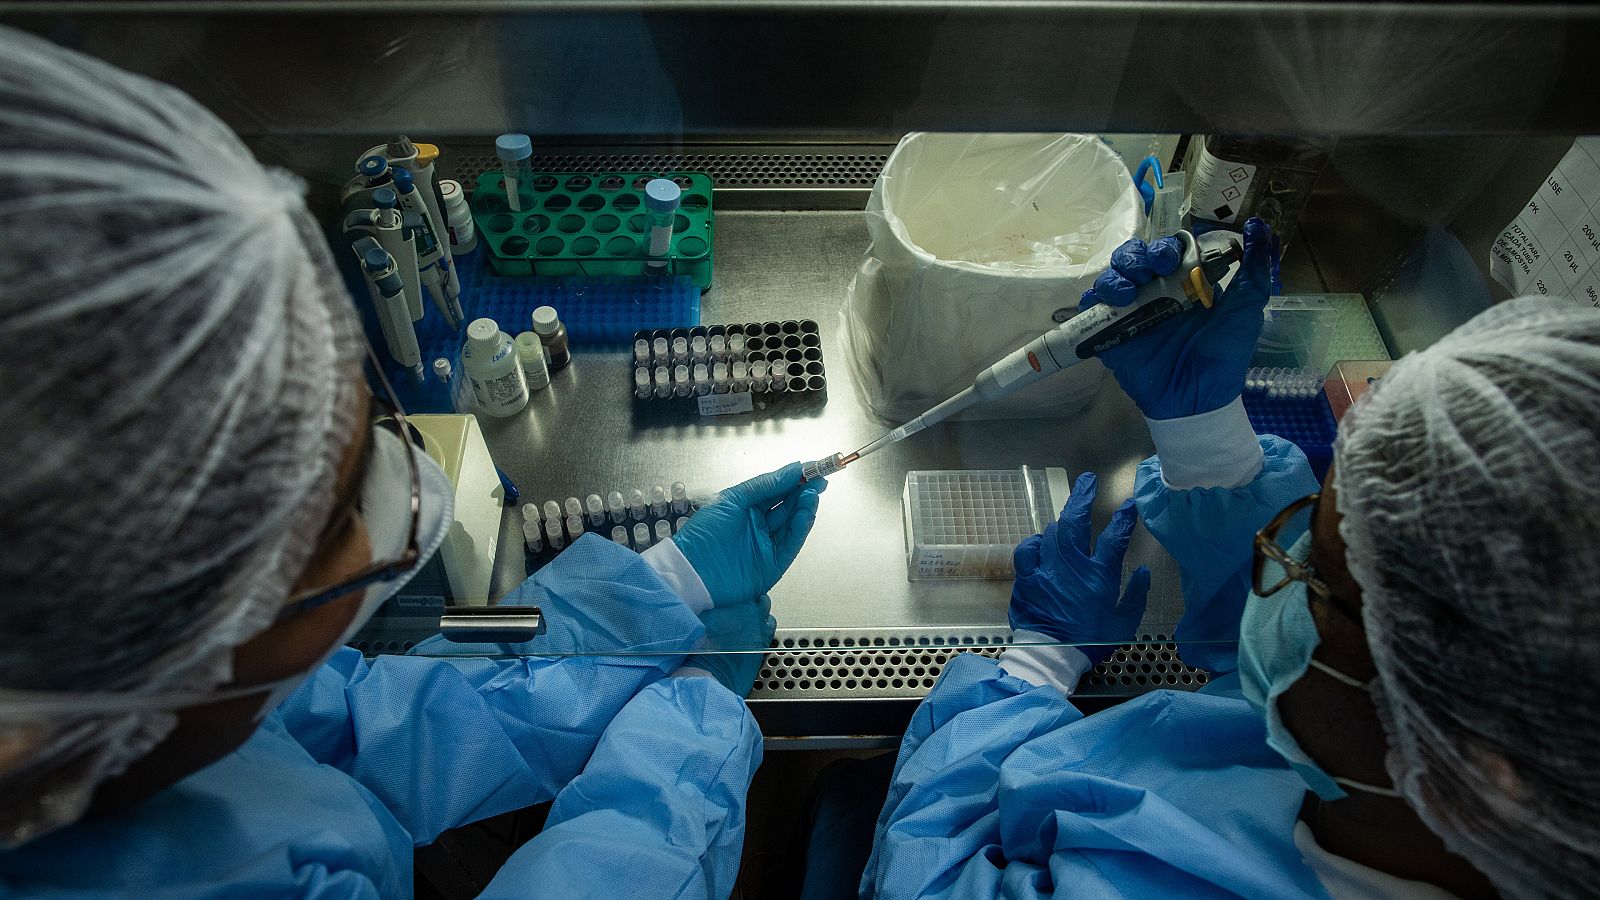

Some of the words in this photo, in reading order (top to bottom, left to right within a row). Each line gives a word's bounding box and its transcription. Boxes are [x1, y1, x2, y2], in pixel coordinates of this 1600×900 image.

[1548, 176, 1562, 196] LISE
[1528, 201, 1539, 214] PK
[1582, 224, 1594, 240] 200
[1504, 231, 1522, 248] CADA
[1521, 247, 1534, 264] TUBO
[1511, 224, 1529, 244] TOTAL
[1527, 242, 1540, 260] PARA
[1492, 246, 1501, 256] DA
[1499, 252, 1513, 265] MIX
[1497, 239, 1509, 248] DE
[1505, 247, 1531, 275] AMOSTRA
[1564, 250, 1573, 262] 20
[1537, 279, 1547, 295] 220
[1586, 285, 1598, 302] 360
